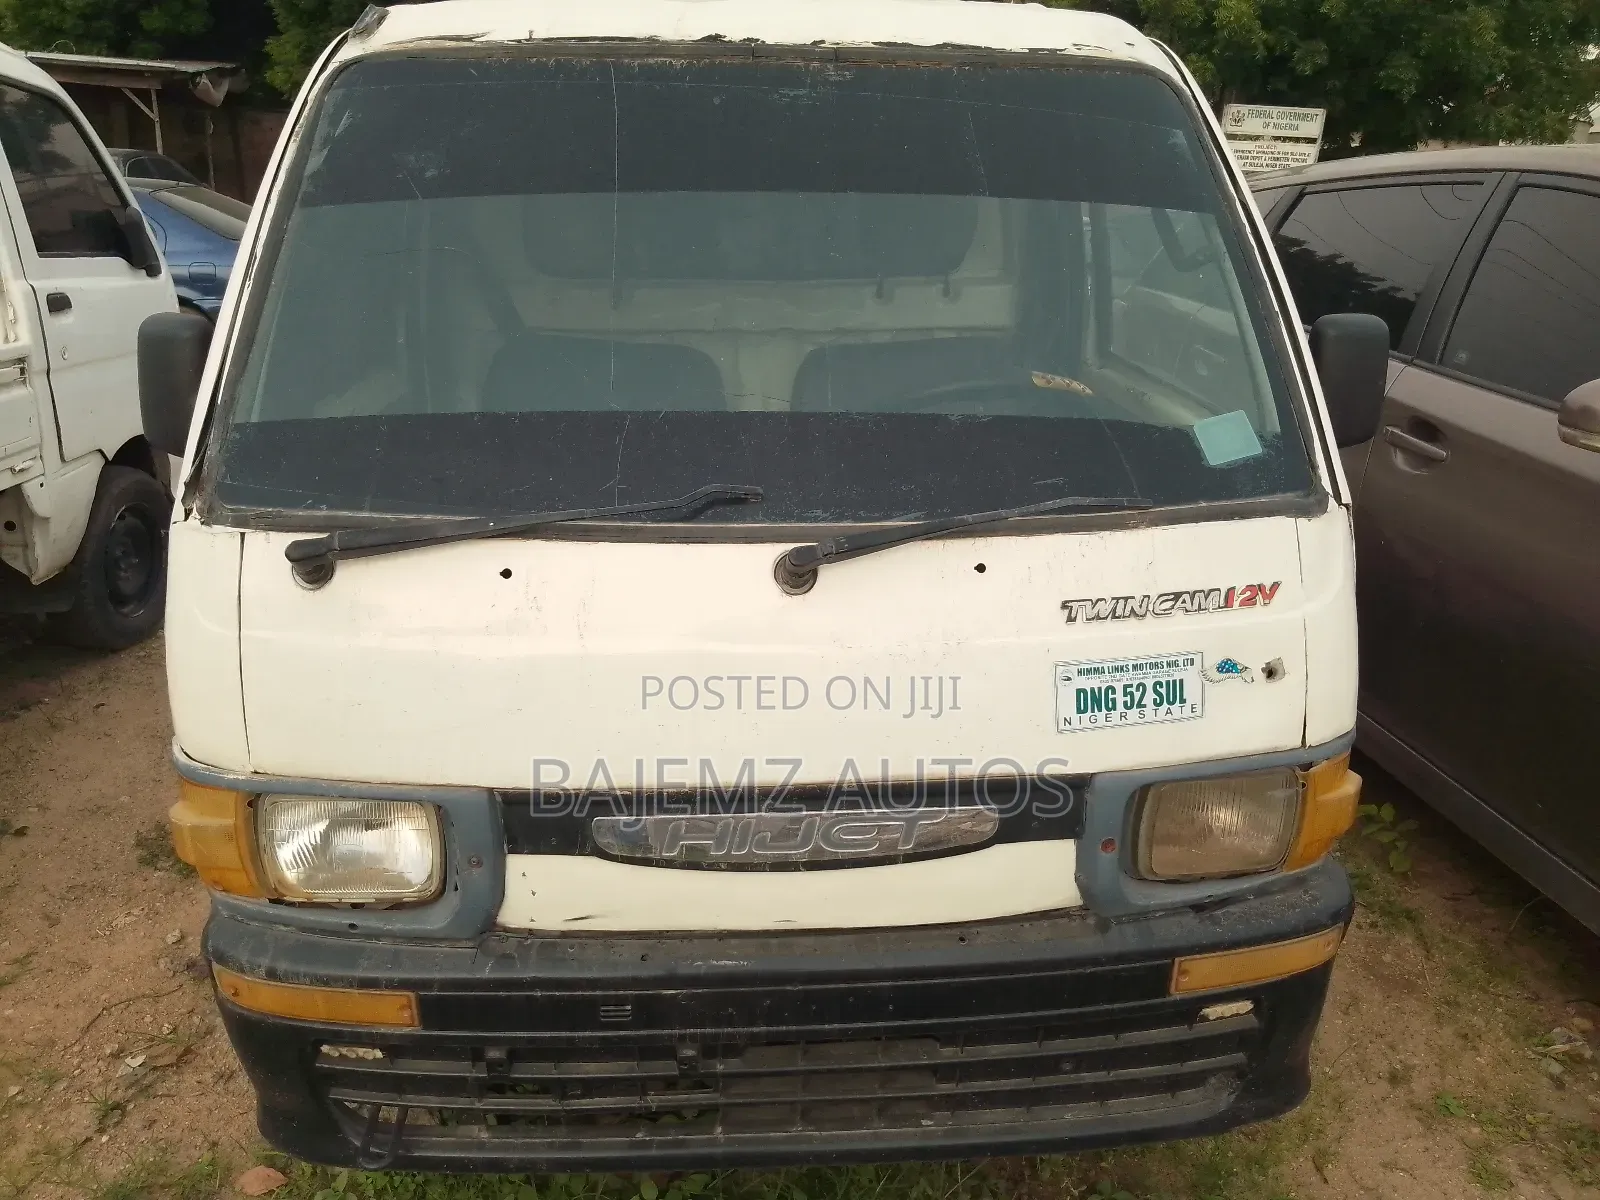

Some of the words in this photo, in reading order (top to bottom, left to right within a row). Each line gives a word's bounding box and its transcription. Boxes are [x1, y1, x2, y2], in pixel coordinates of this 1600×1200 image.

[1246, 109, 1274, 120] FEDERAL
[1276, 111, 1319, 122] GOVERNMENT
[1262, 121, 1271, 129] OF
[1272, 122, 1299, 131] NIGERIA
[1077, 666, 1106, 677] HIMMA
[1107, 663, 1130, 675] LINKS
[1131, 661, 1164, 672] MOTORS
[1166, 659, 1181, 669] NIG.
[1182, 657, 1195, 667] LTD
[1075, 684, 1117, 715] DNG
[1122, 682, 1147, 710] 52
[1152, 678, 1187, 707] SUL
[1063, 711, 1128, 727] NIGER
[1138, 703, 1198, 720] STATE
[662, 811, 946, 857] HIJET
